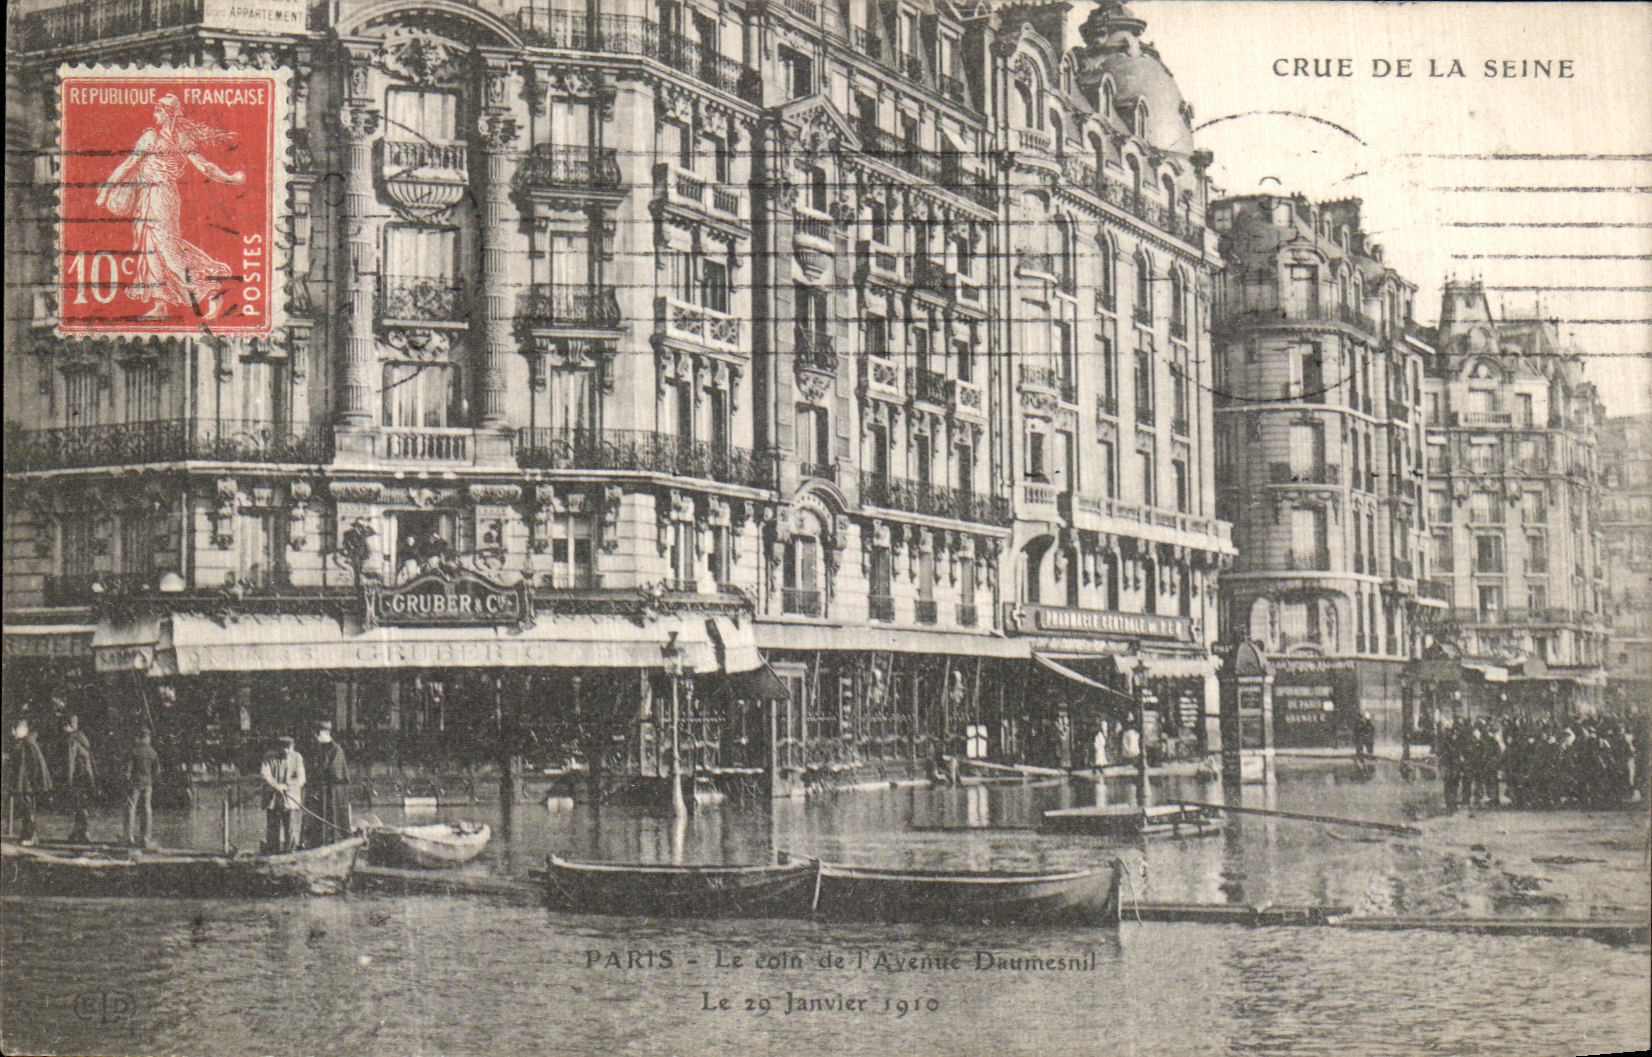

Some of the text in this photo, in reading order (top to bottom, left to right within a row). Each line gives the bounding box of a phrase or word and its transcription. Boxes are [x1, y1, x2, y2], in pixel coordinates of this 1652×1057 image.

[229, 6, 304, 23] APPARTEMENT
[70, 87, 265, 108] REPUBLIQUE FRANÇAISE
[242, 233, 262, 316] POSTES
[392, 593, 473, 614] GRUBER
